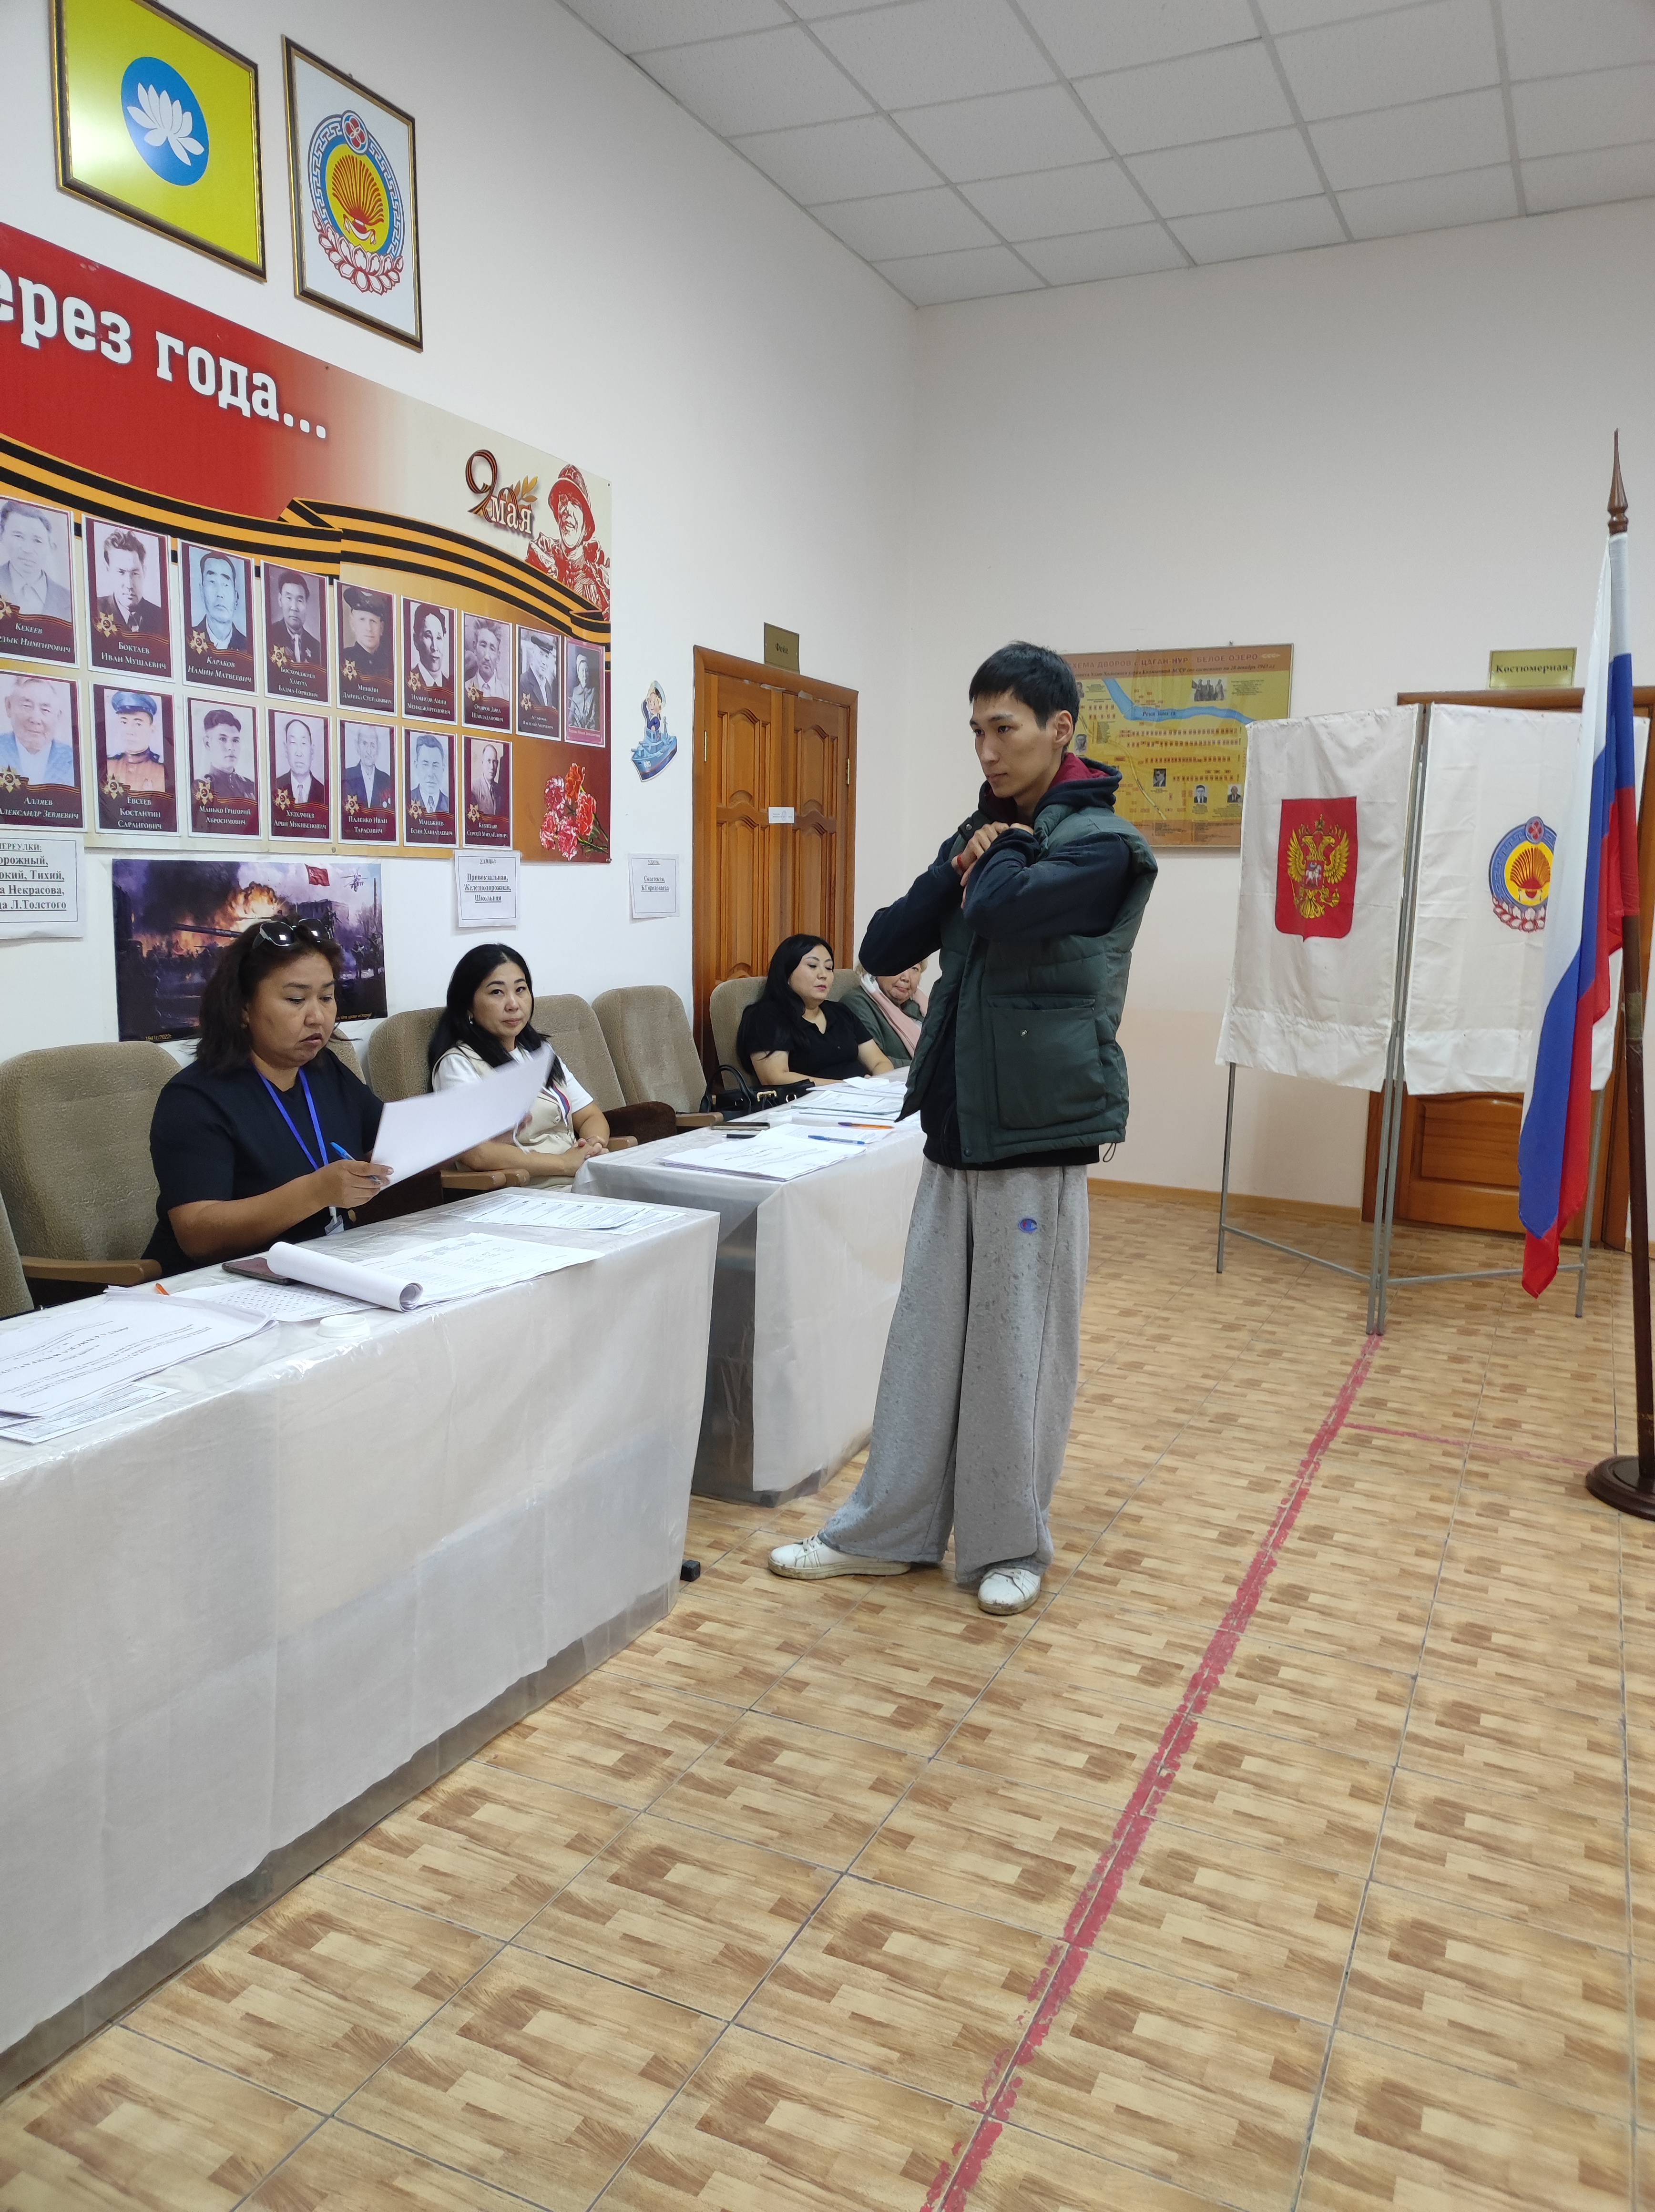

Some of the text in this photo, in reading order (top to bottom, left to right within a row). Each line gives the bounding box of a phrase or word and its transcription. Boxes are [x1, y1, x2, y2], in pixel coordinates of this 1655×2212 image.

[156, 330, 327, 439] года...
[101, 652, 123, 663] ИВАН
[1197, 655, 1226, 663] БЕЛОЕ
[1496, 665, 1568, 674] Костюмерная
[30, 870, 65, 881] Тихий,
[8, 884, 65, 896] Некрасова,
